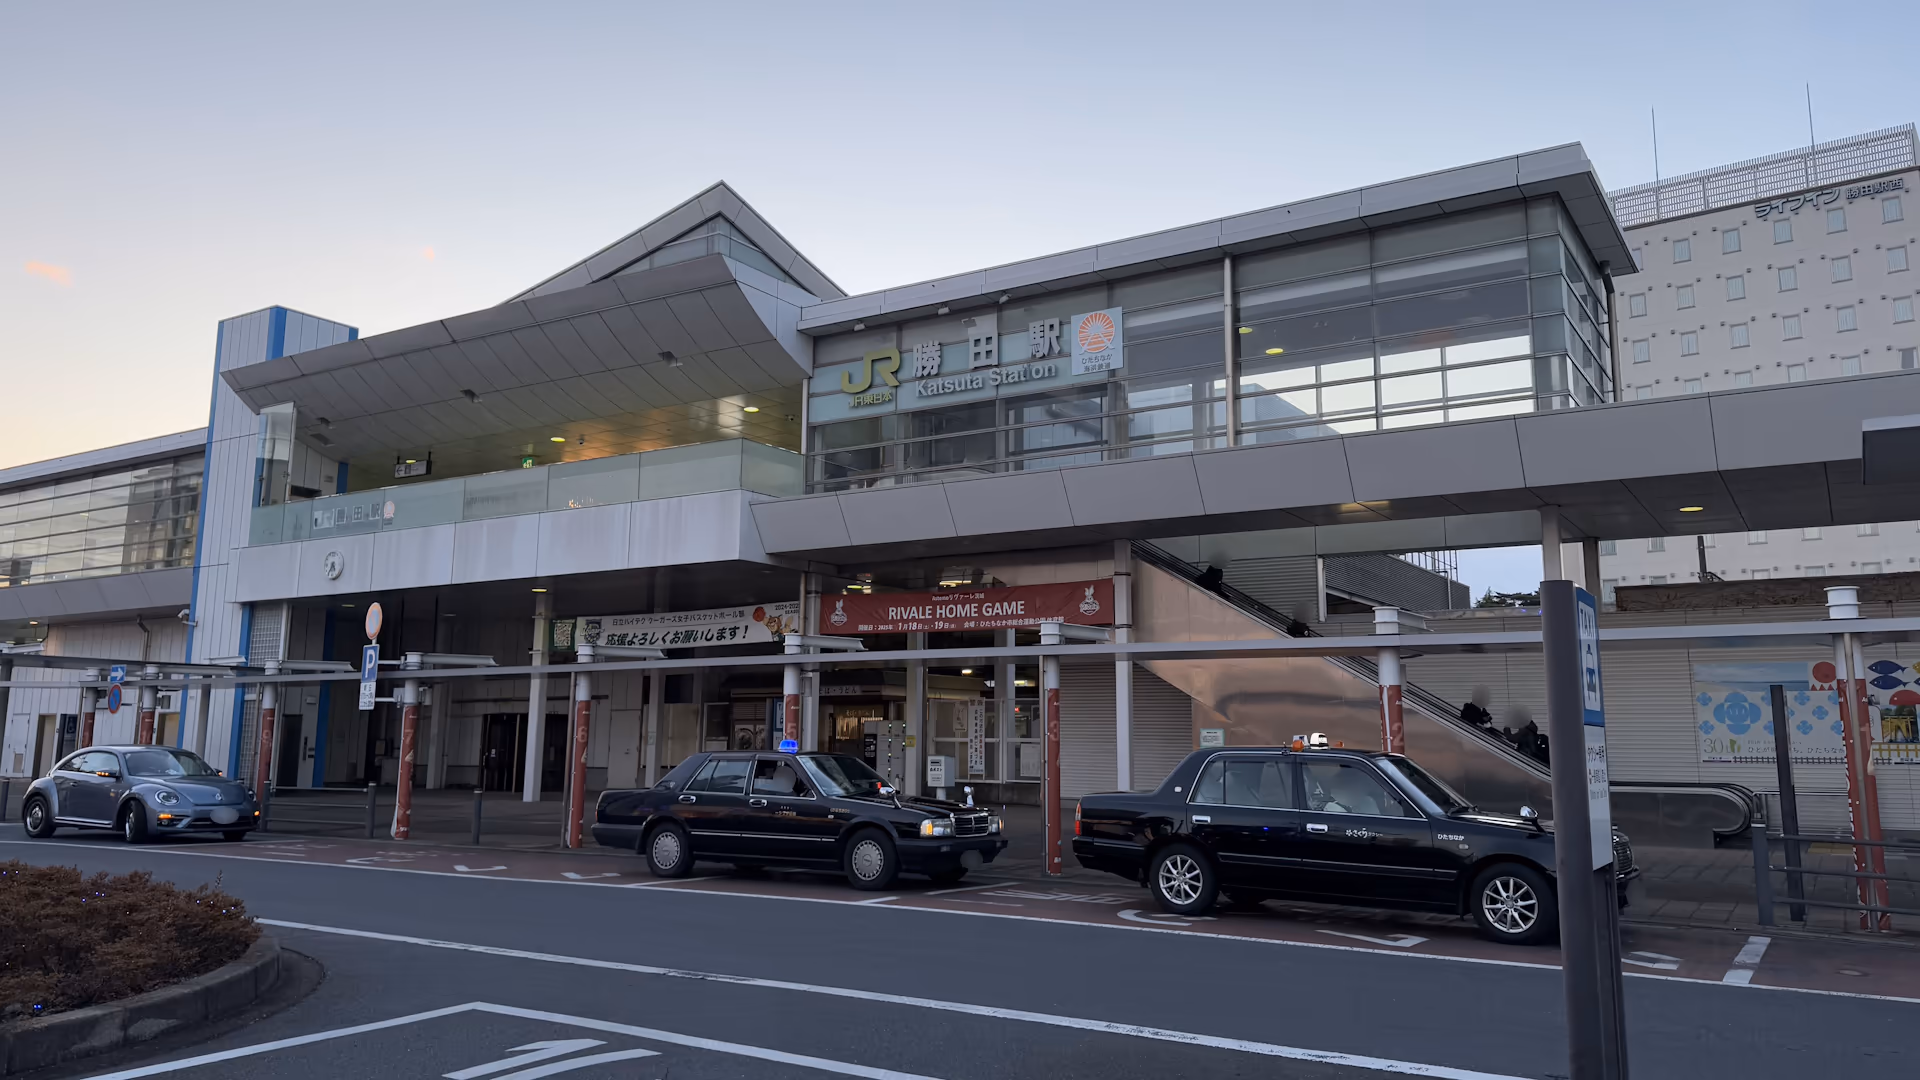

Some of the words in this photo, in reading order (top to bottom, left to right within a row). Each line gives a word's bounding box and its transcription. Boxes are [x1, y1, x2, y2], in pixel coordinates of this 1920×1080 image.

[1754, 188, 1841, 218] ライフイン
[1846, 178, 1904, 199] 勝田駅西
[912, 317, 1061, 378] 勝田駅
[1081, 353, 1113, 365] ひたちなか
[841, 349, 901, 394] JR
[915, 375, 984, 398] Katsuta
[988, 361, 1057, 387] Station
[849, 390, 893, 407] JR東日本
[775, 603, 799, 611] 2024-202
[888, 605, 933, 621] RIVALE
[936, 603, 979, 619] HOME
[982, 600, 1025, 616] GAME
[1580, 608, 1595, 640] TAXI
[364, 649, 375, 679] P
[577, 726, 587, 743] 6
[1437, 833, 1465, 841] ひたちなか
